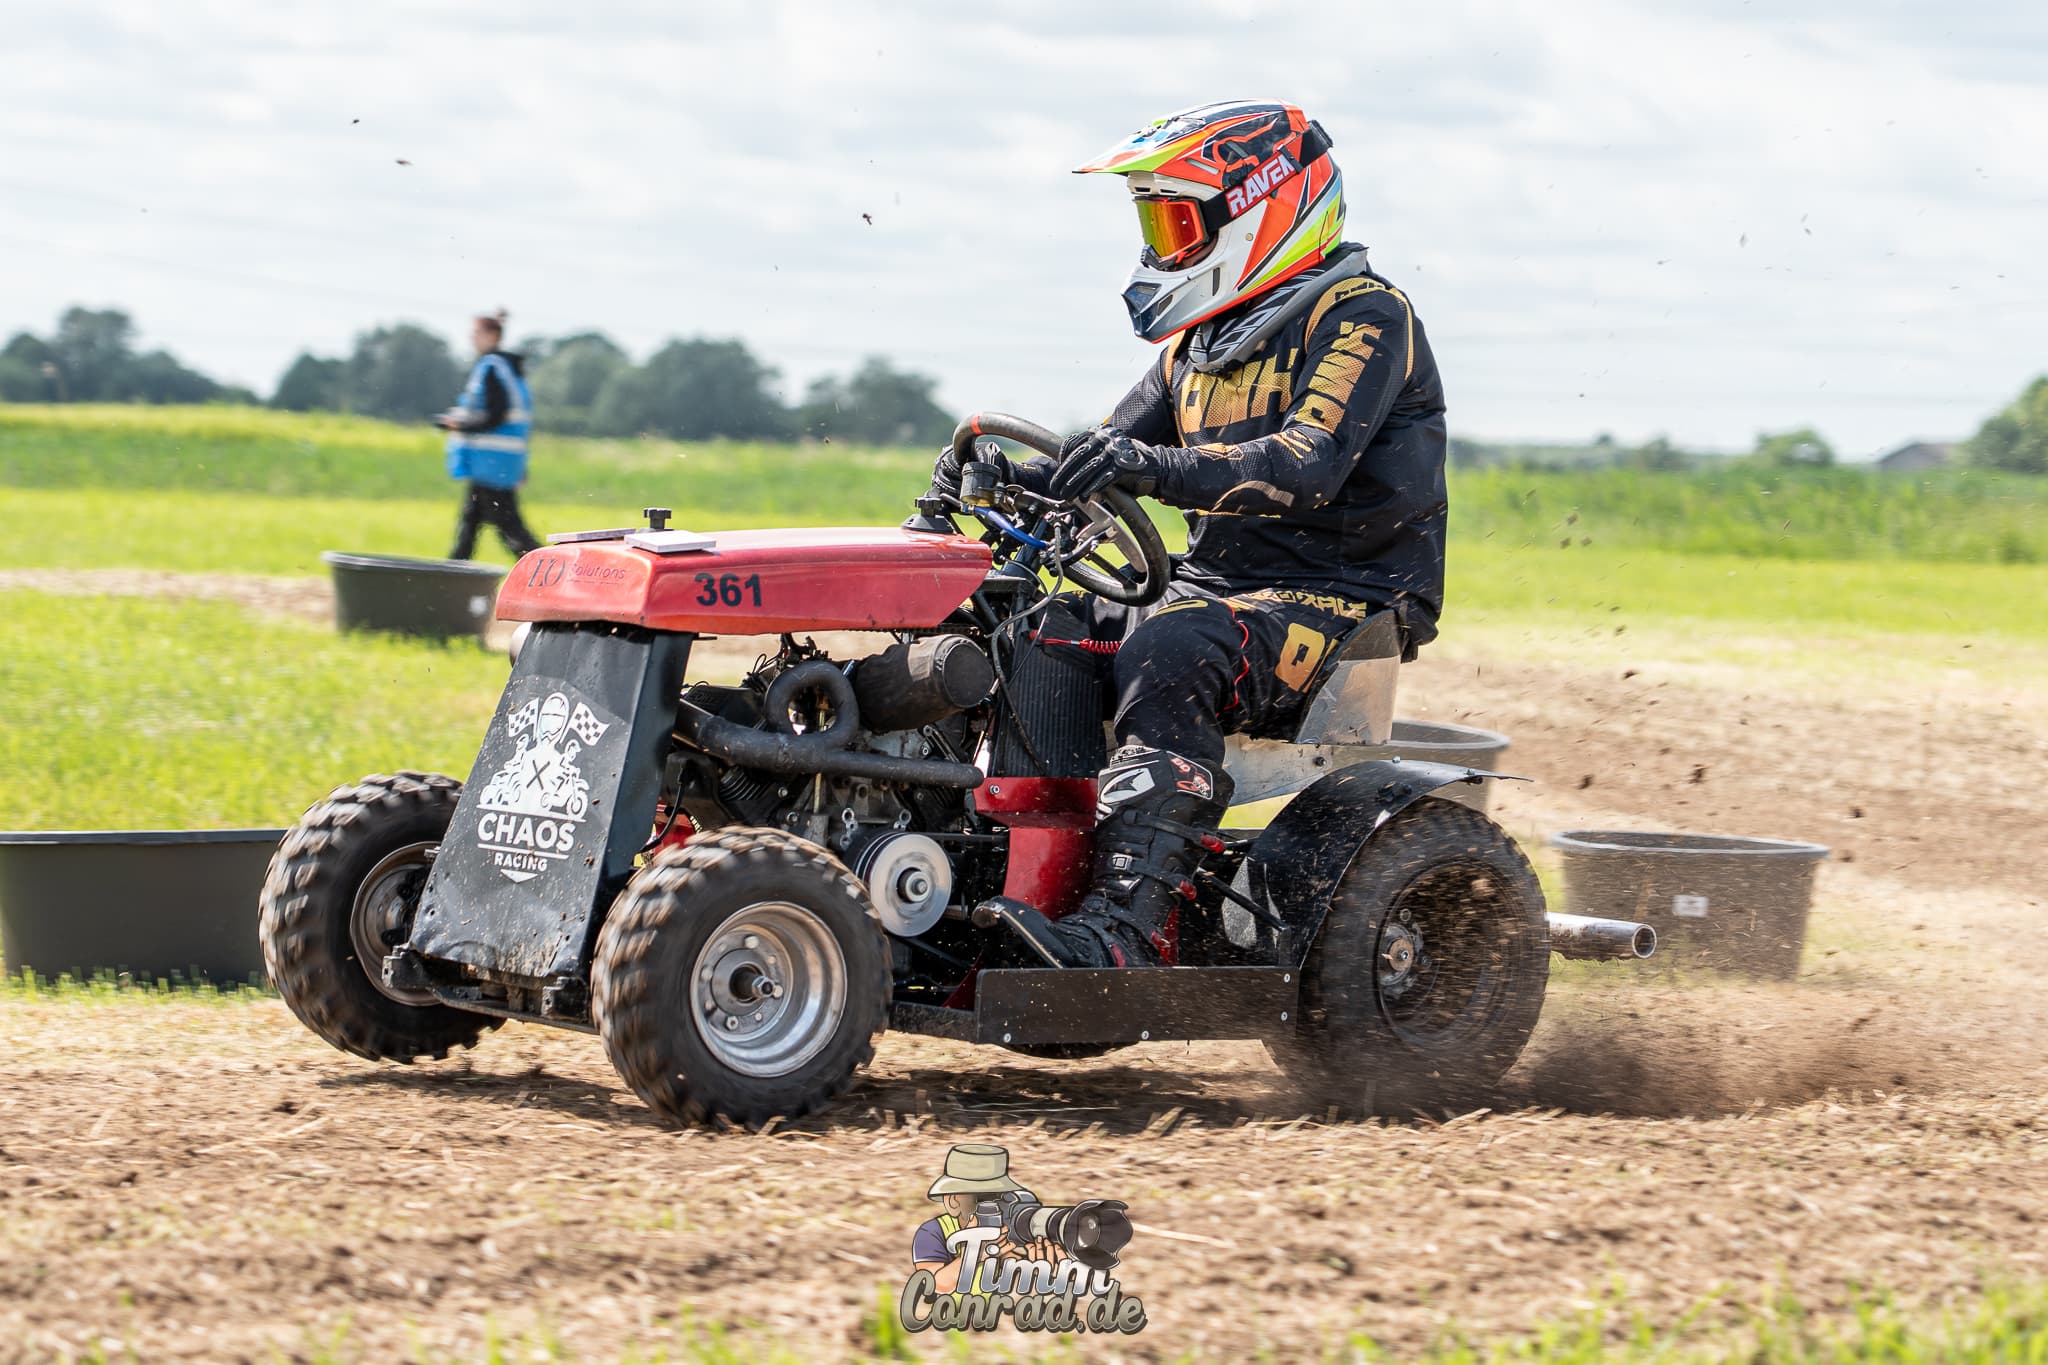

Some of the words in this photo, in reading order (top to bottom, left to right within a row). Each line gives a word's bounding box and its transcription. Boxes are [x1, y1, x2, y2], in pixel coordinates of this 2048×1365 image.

[1226, 153, 1296, 216] RAVEN
[694, 572, 763, 607] 361
[477, 811, 576, 852] CHAOS
[493, 852, 549, 872] RACING
